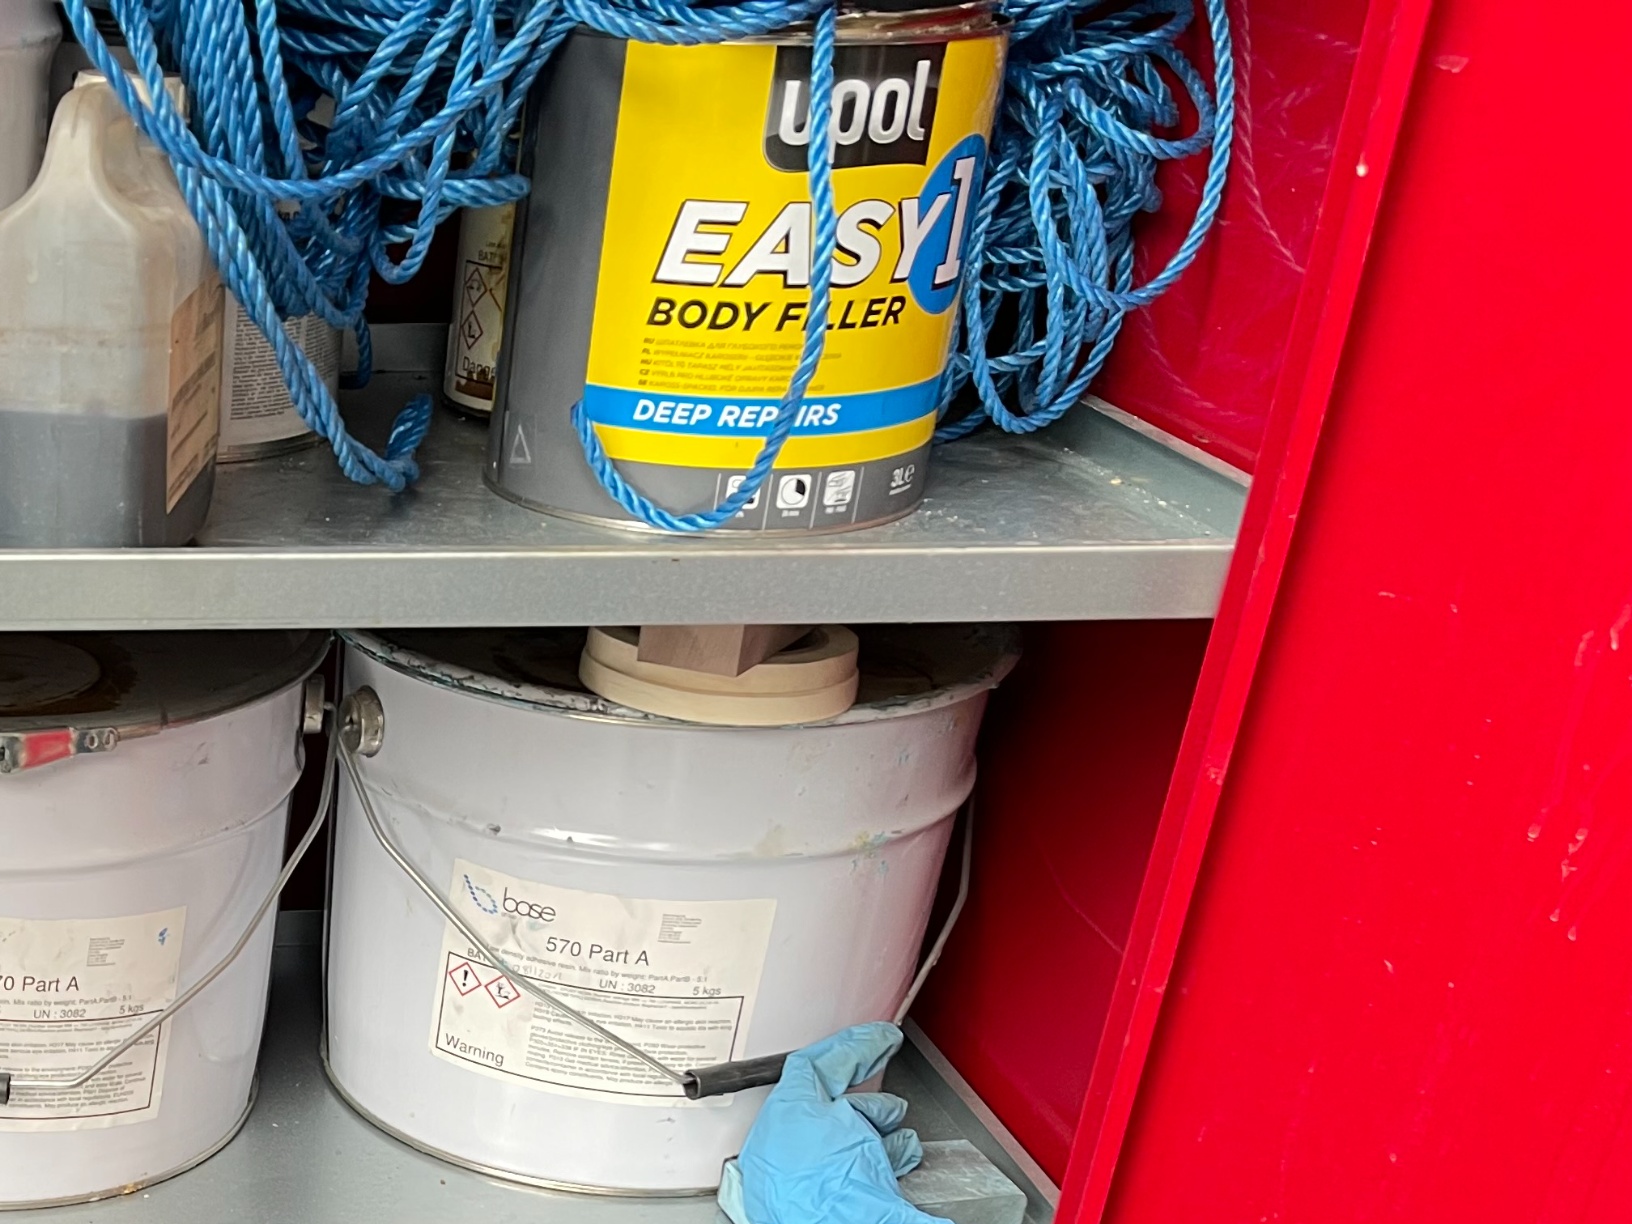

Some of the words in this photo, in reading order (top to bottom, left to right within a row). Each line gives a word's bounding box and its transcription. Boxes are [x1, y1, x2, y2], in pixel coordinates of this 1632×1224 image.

[652, 198, 952, 289] EASY
[647, 297, 772, 331] BODY
[632, 398, 713, 426] DEEP
[717, 403, 842, 428] REPIRS
[502, 887, 557, 922] base
[545, 937, 582, 957] 570
[588, 945, 629, 965] Part
[634, 950, 650, 966] A
[21, 976, 60, 993] Part
[66, 976, 80, 992] A
[599, 979, 618, 990] UN
[626, 982, 656, 994] 3082
[701, 986, 722, 998] kgs
[33, 1009, 52, 1020] UN
[59, 1008, 87, 1019] 3082
[128, 1003, 145, 1016] kgs
[445, 1033, 505, 1067] Warning
